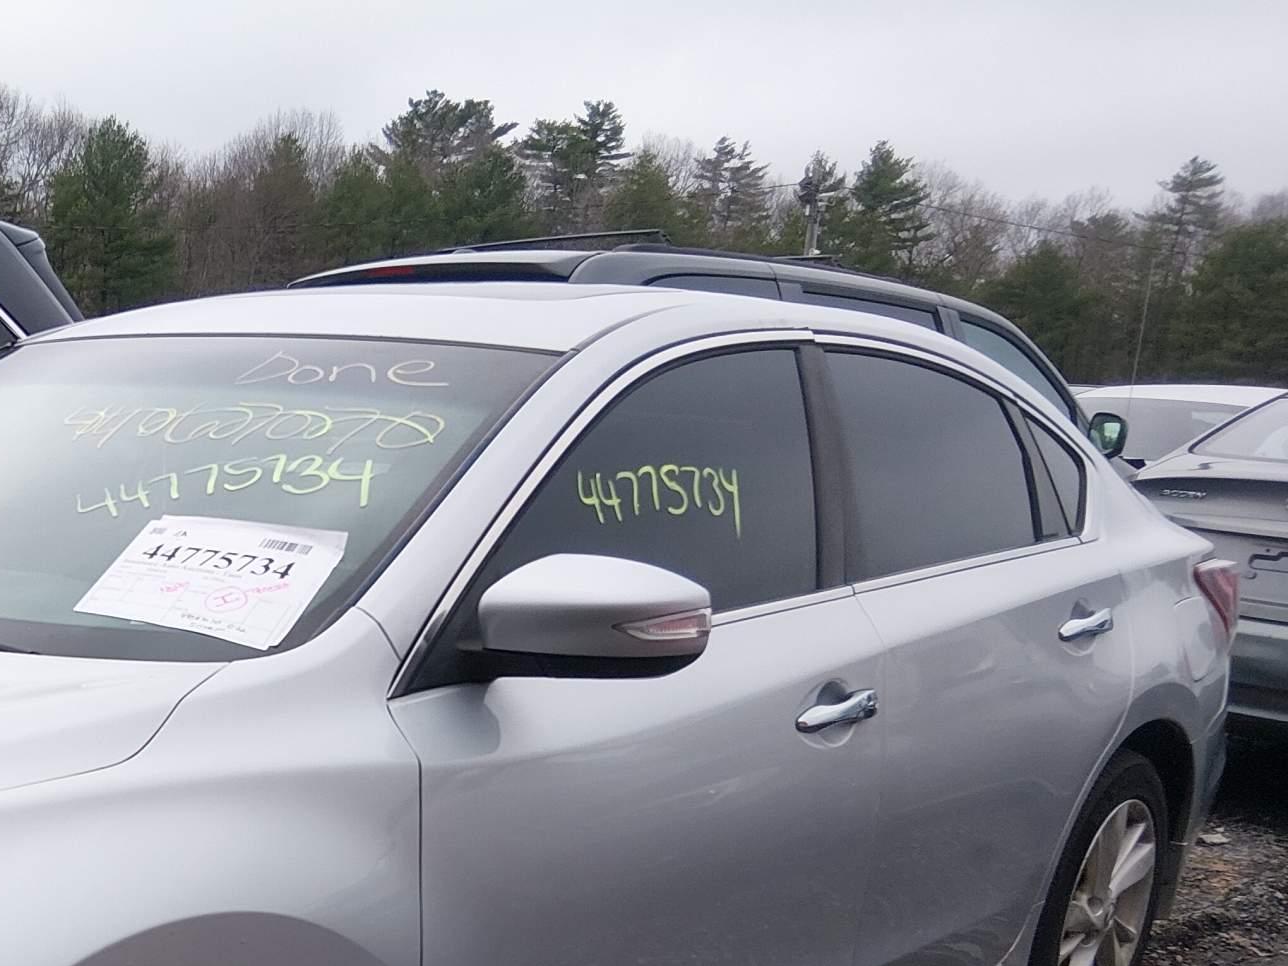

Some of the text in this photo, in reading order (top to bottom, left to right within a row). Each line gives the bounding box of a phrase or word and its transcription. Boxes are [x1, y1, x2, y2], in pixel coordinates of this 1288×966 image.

[235, 351, 449, 386] Done
[76, 453, 375, 518] 44775734
[577, 463, 742, 538] 44775734
[142, 542, 296, 580] 44775734
